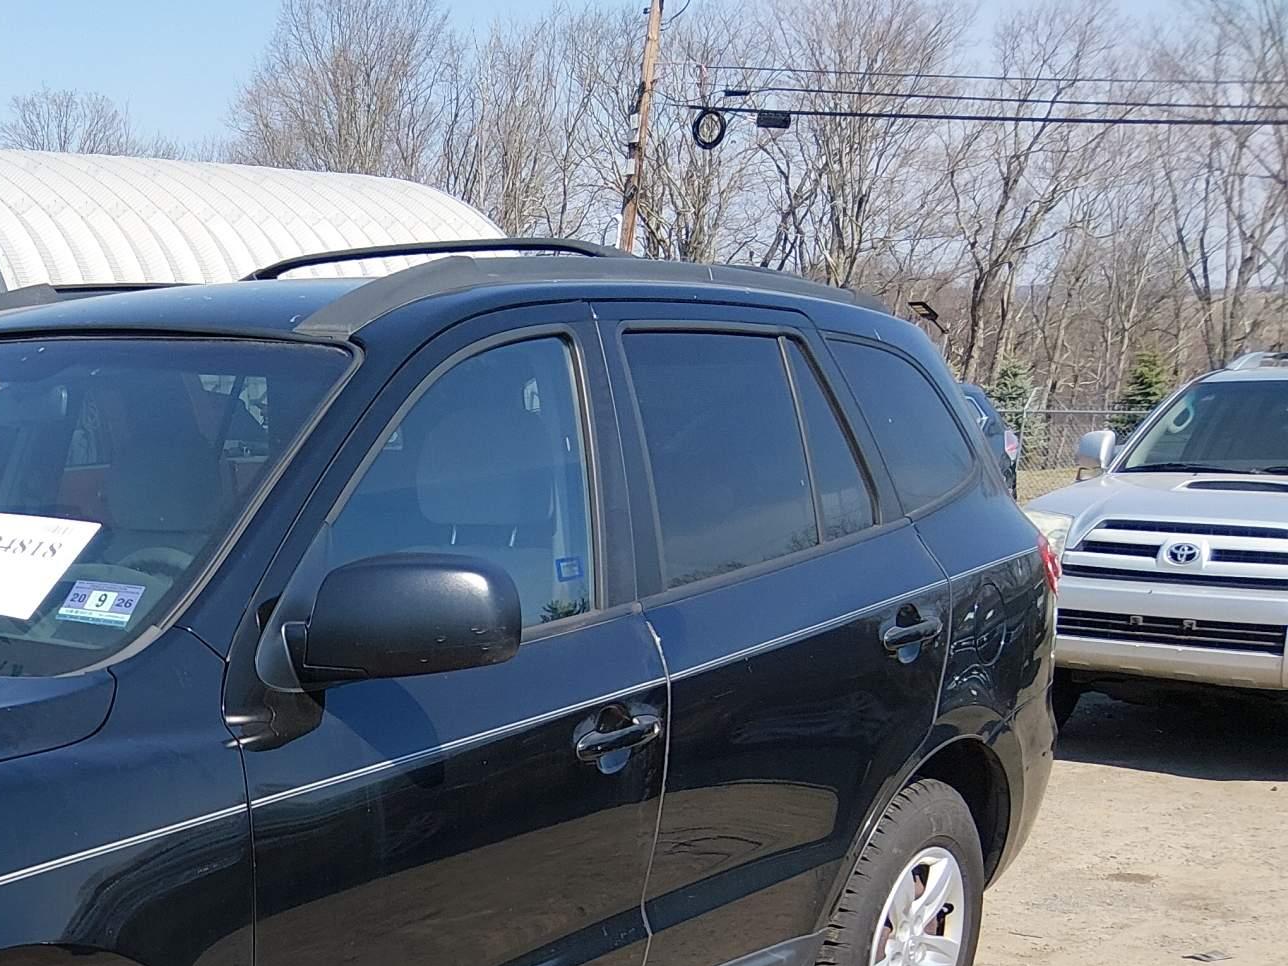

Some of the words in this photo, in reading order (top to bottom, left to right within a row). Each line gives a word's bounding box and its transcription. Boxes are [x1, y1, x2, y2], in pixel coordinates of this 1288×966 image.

[70, 592, 87, 603] 20
[95, 593, 108, 608] 9
[115, 598, 134, 608] 26
